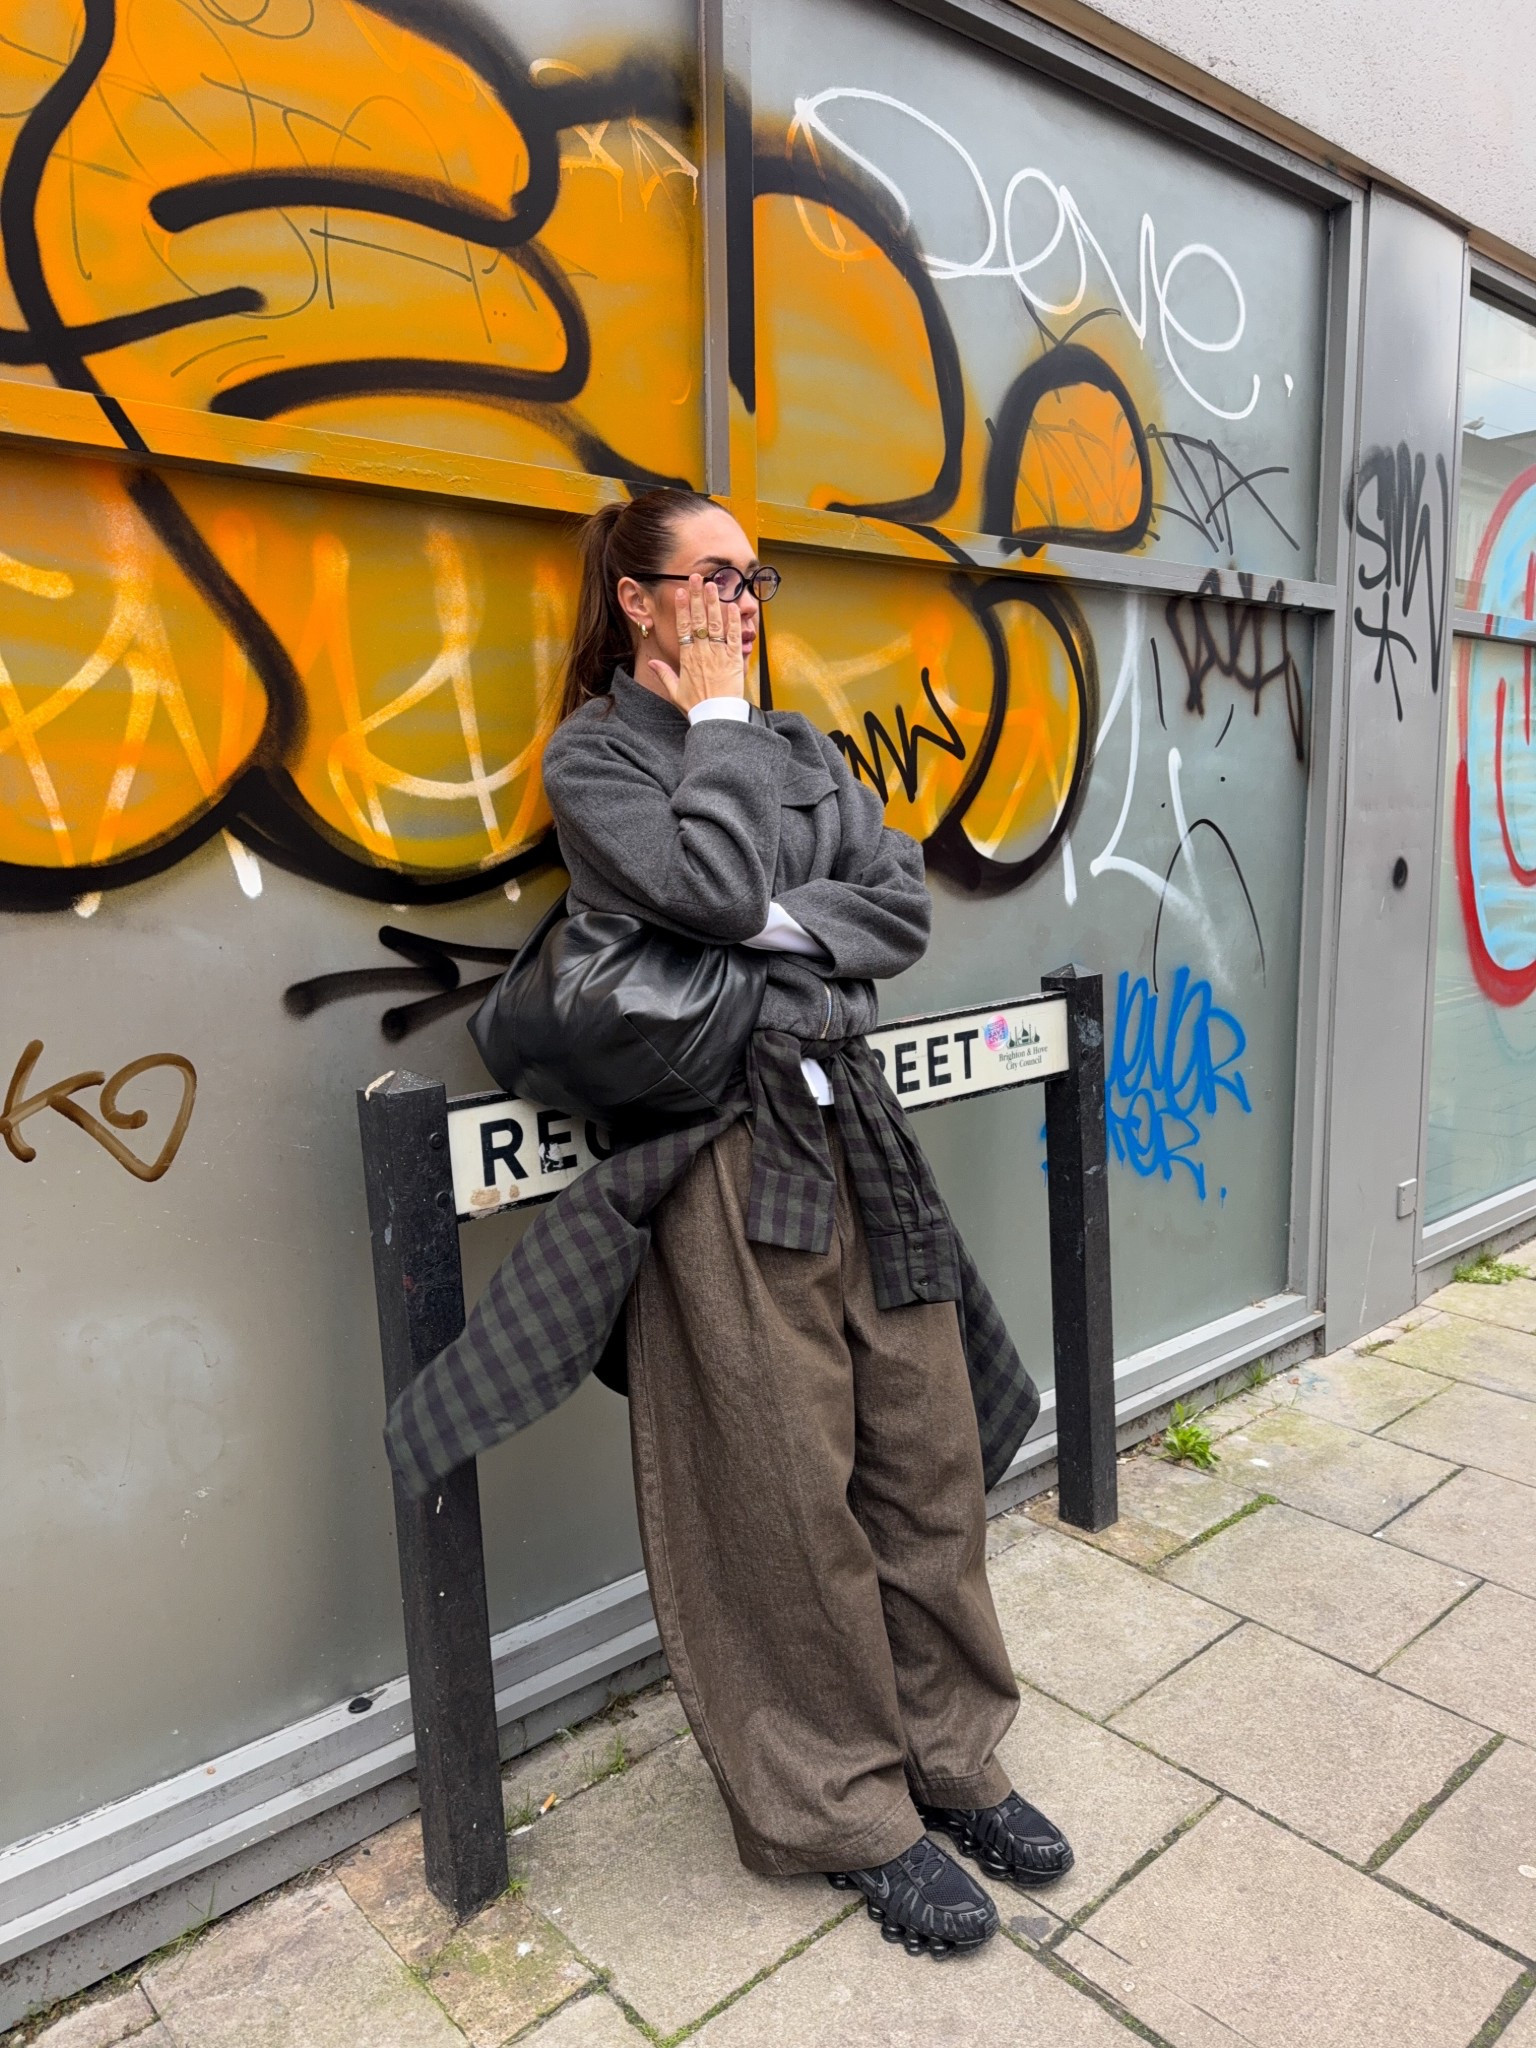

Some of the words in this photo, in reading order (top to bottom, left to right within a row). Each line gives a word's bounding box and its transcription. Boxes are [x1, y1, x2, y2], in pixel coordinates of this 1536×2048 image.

[871, 1029, 979, 1095] EET
[999, 1050, 1026, 1062] Brighton
[1033, 1045, 1049, 1055] Hove
[1006, 1059, 1018, 1071] City
[1019, 1055, 1042, 1067] Council
